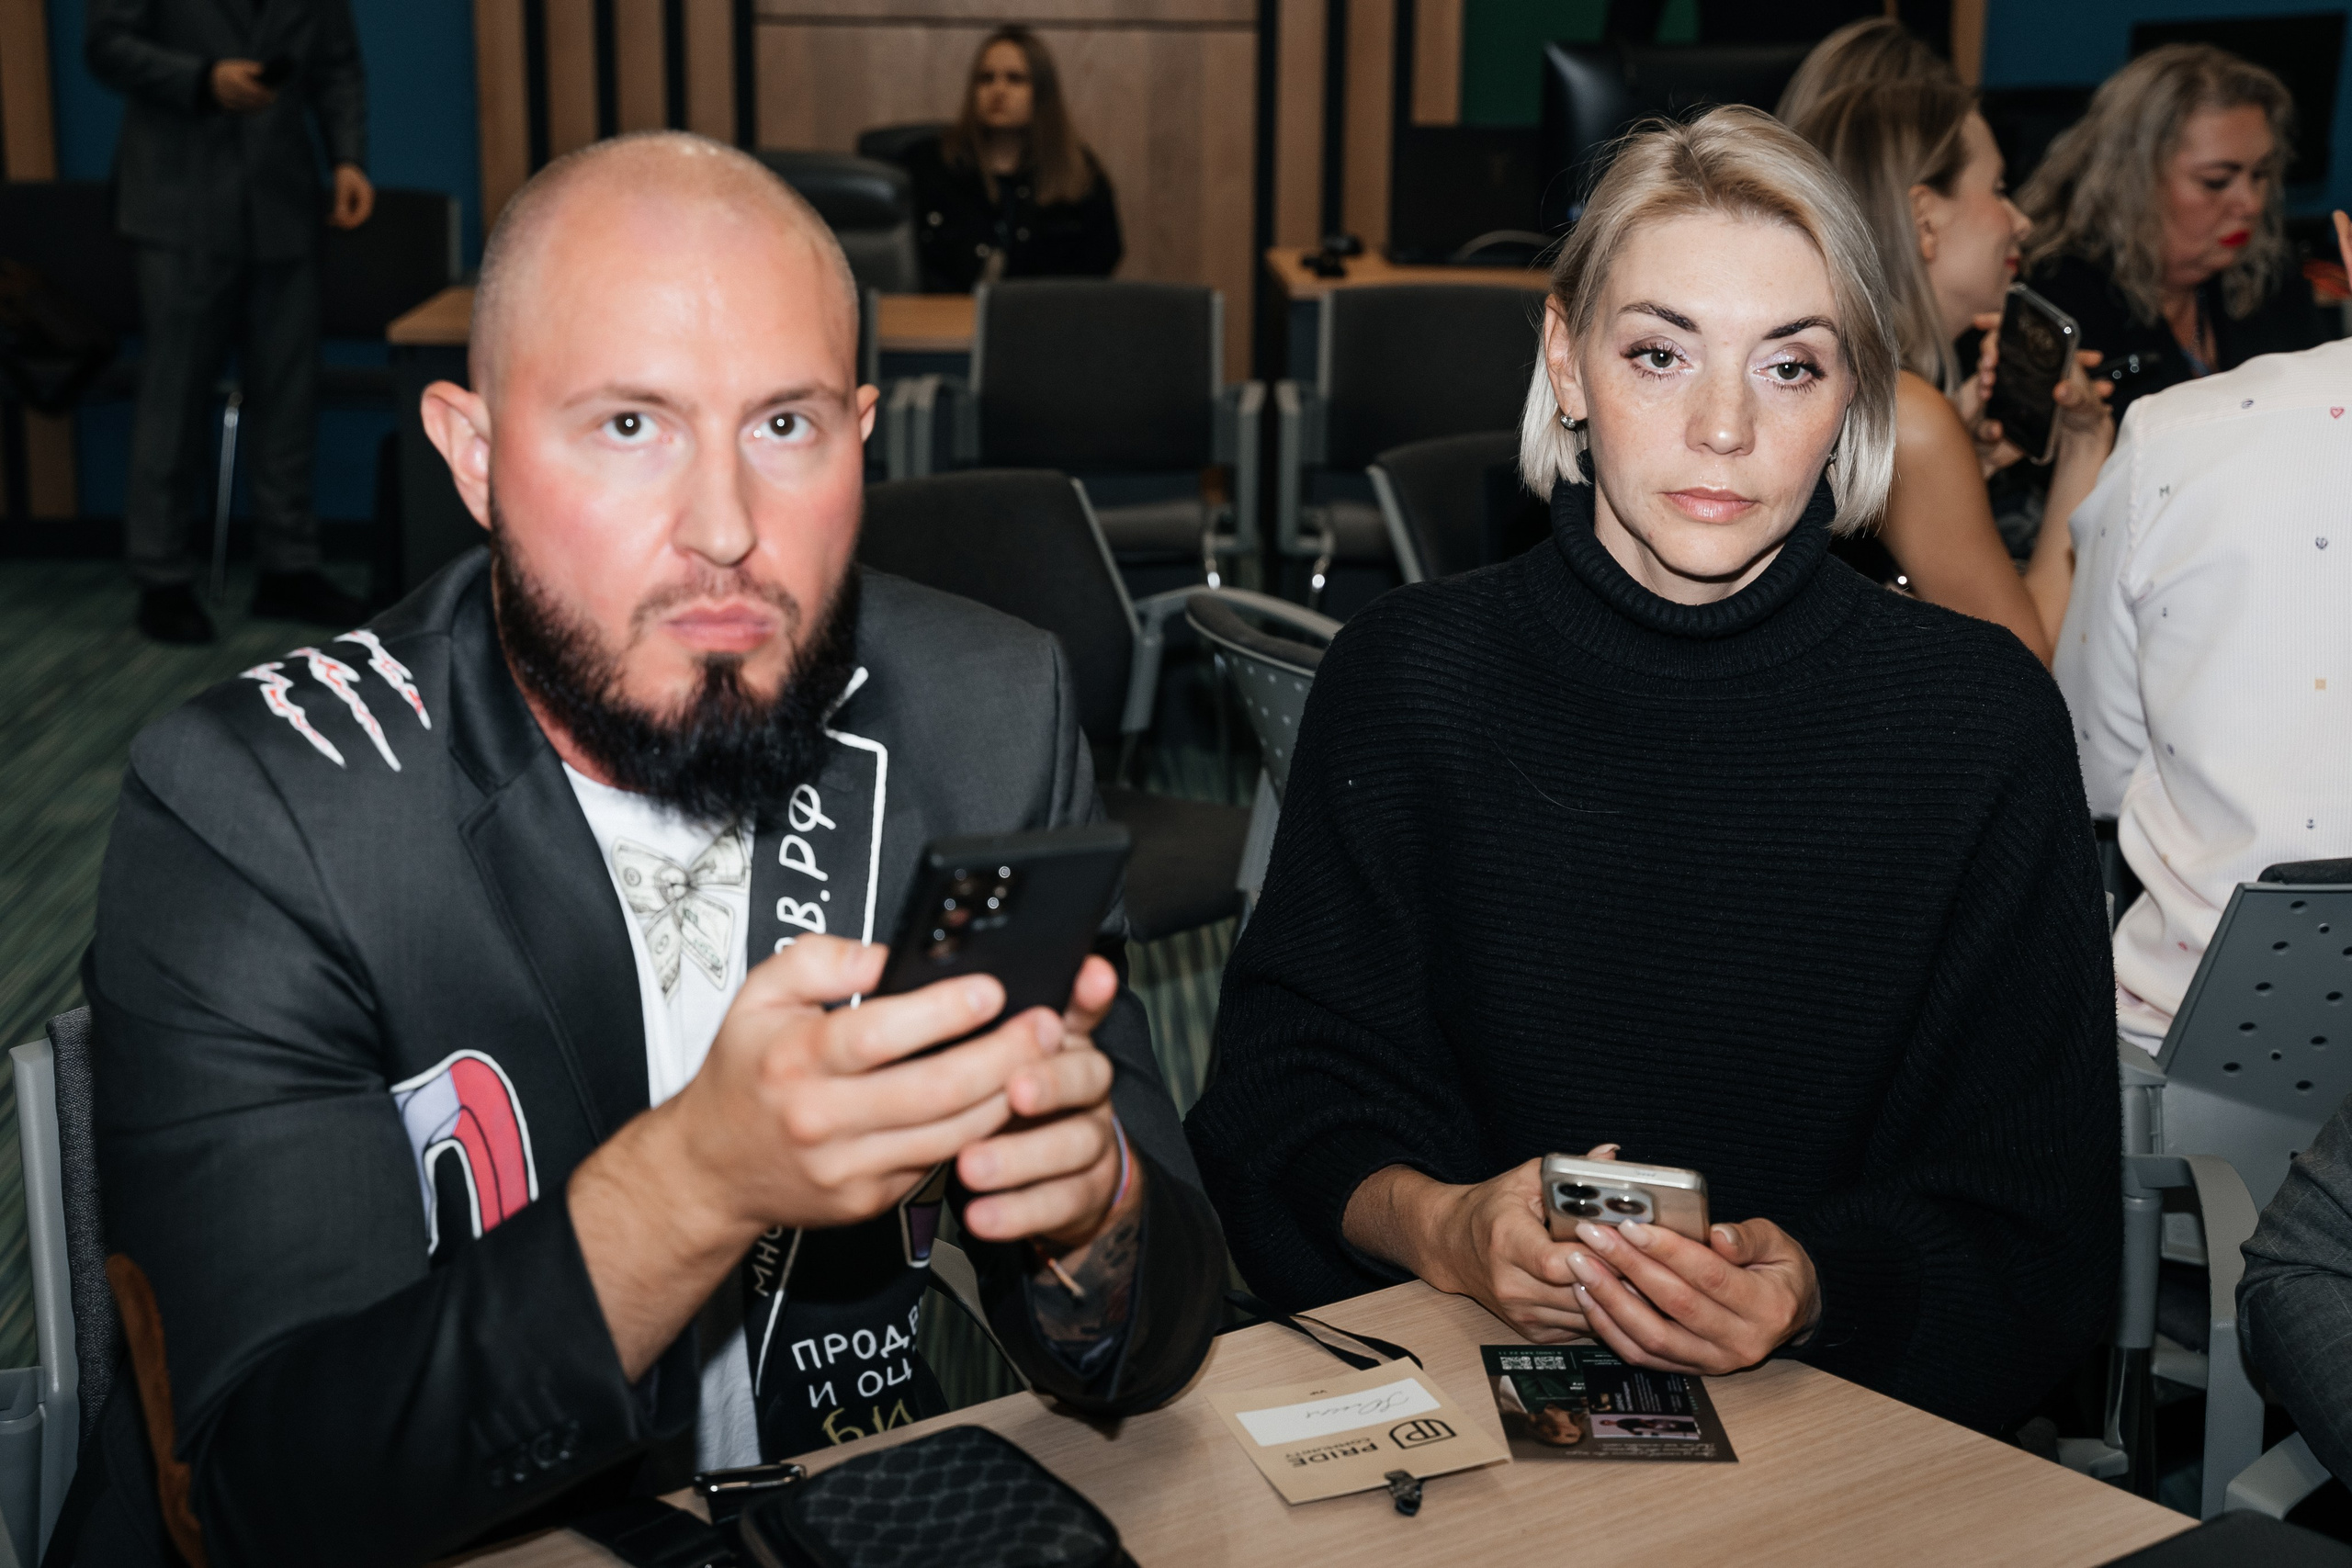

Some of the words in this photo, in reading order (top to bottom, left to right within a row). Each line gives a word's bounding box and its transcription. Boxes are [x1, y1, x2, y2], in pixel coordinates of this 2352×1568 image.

[775, 784, 837, 953] В.РФ
[808, 1381, 837, 1408] И
[857, 1350, 915, 1397] ОЦ
[1290, 1442, 1378, 1468] PRIDE
